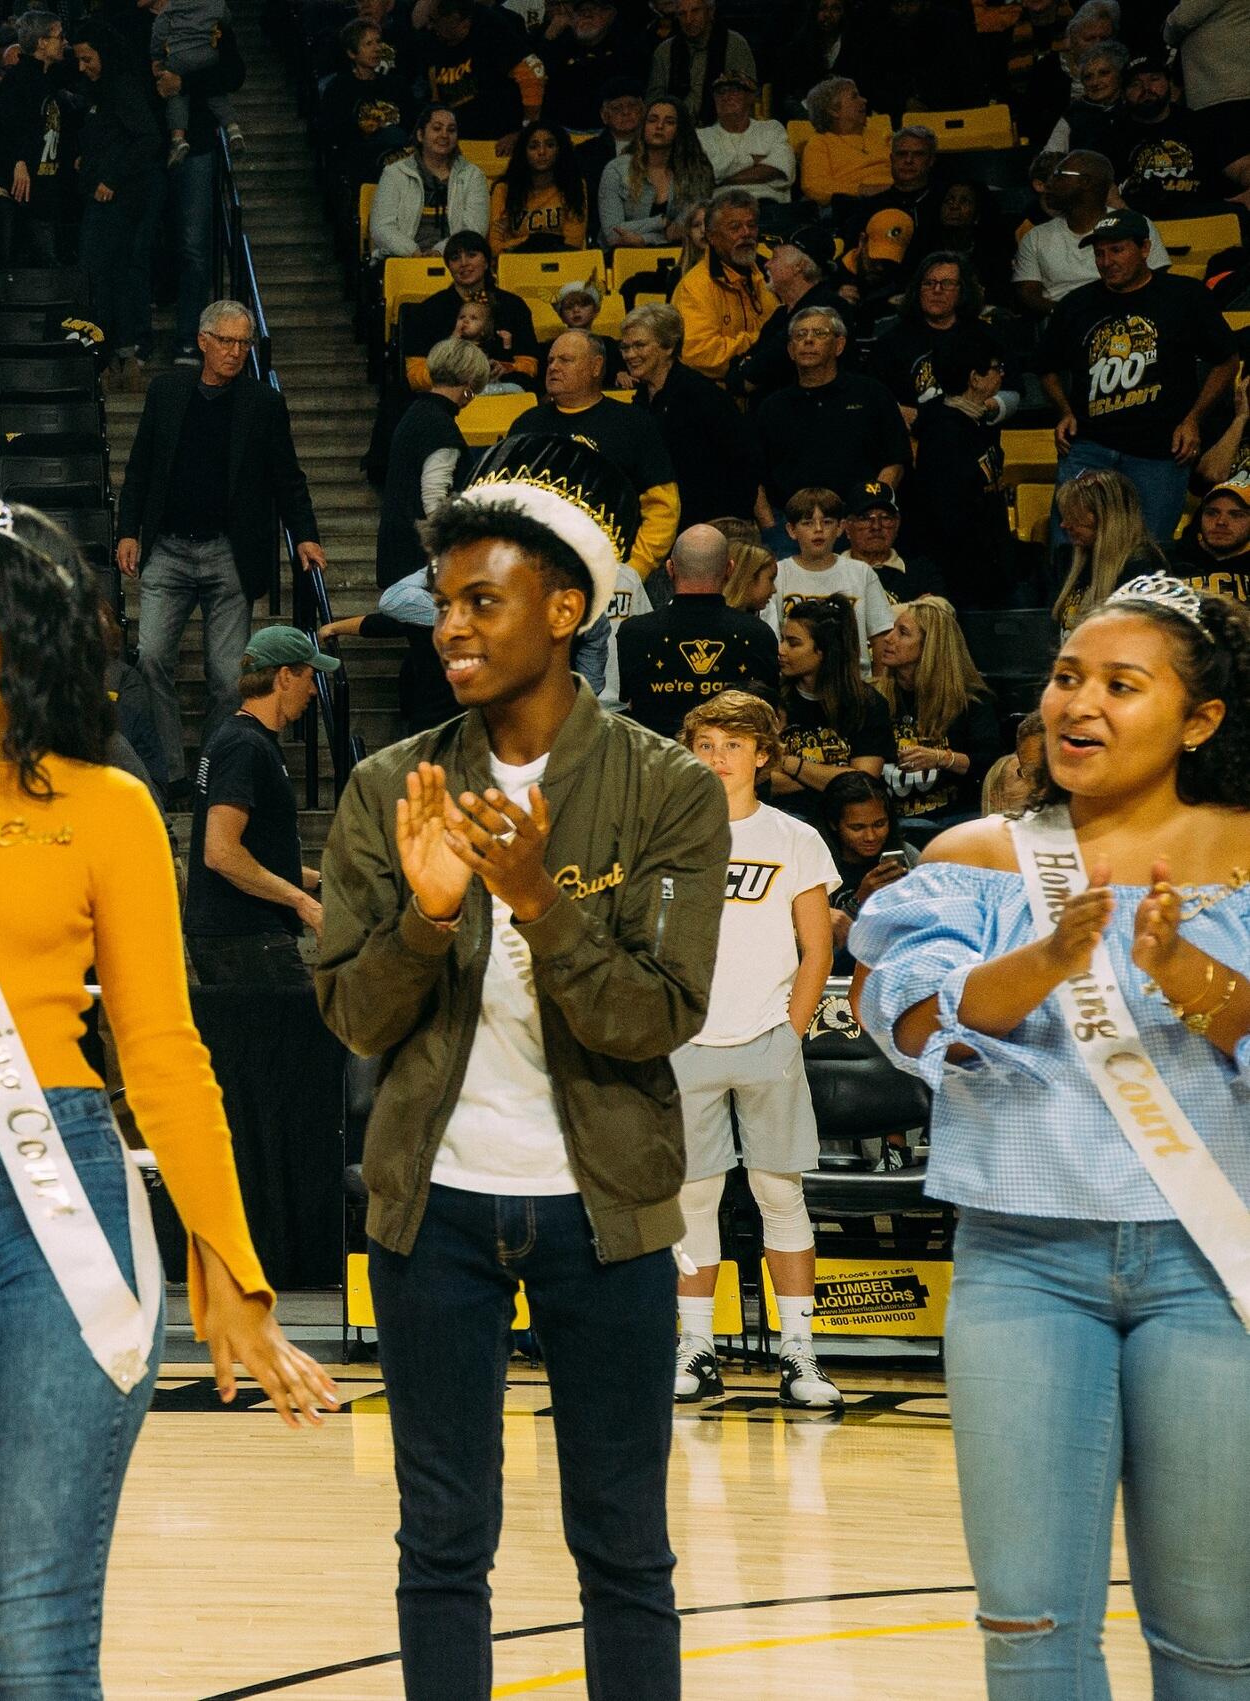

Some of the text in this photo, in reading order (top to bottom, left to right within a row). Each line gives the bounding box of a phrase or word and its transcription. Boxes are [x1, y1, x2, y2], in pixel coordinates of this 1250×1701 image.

[511, 207, 562, 232] VCU
[1088, 384, 1162, 418] SELLOUT
[651, 680, 731, 695] we're ga
[553, 862, 625, 900] Court
[1033, 851, 1194, 1157] Homeing Court
[6, 1106, 79, 1220] Court
[839, 1272, 870, 1280] FLOORS
[891, 1267, 915, 1275] LESS!
[827, 1280, 894, 1296] LUMBER
[818, 1302, 918, 1316] www.lumberliquidators.com
[820, 1311, 916, 1327] 1-800-HARDWOOD
